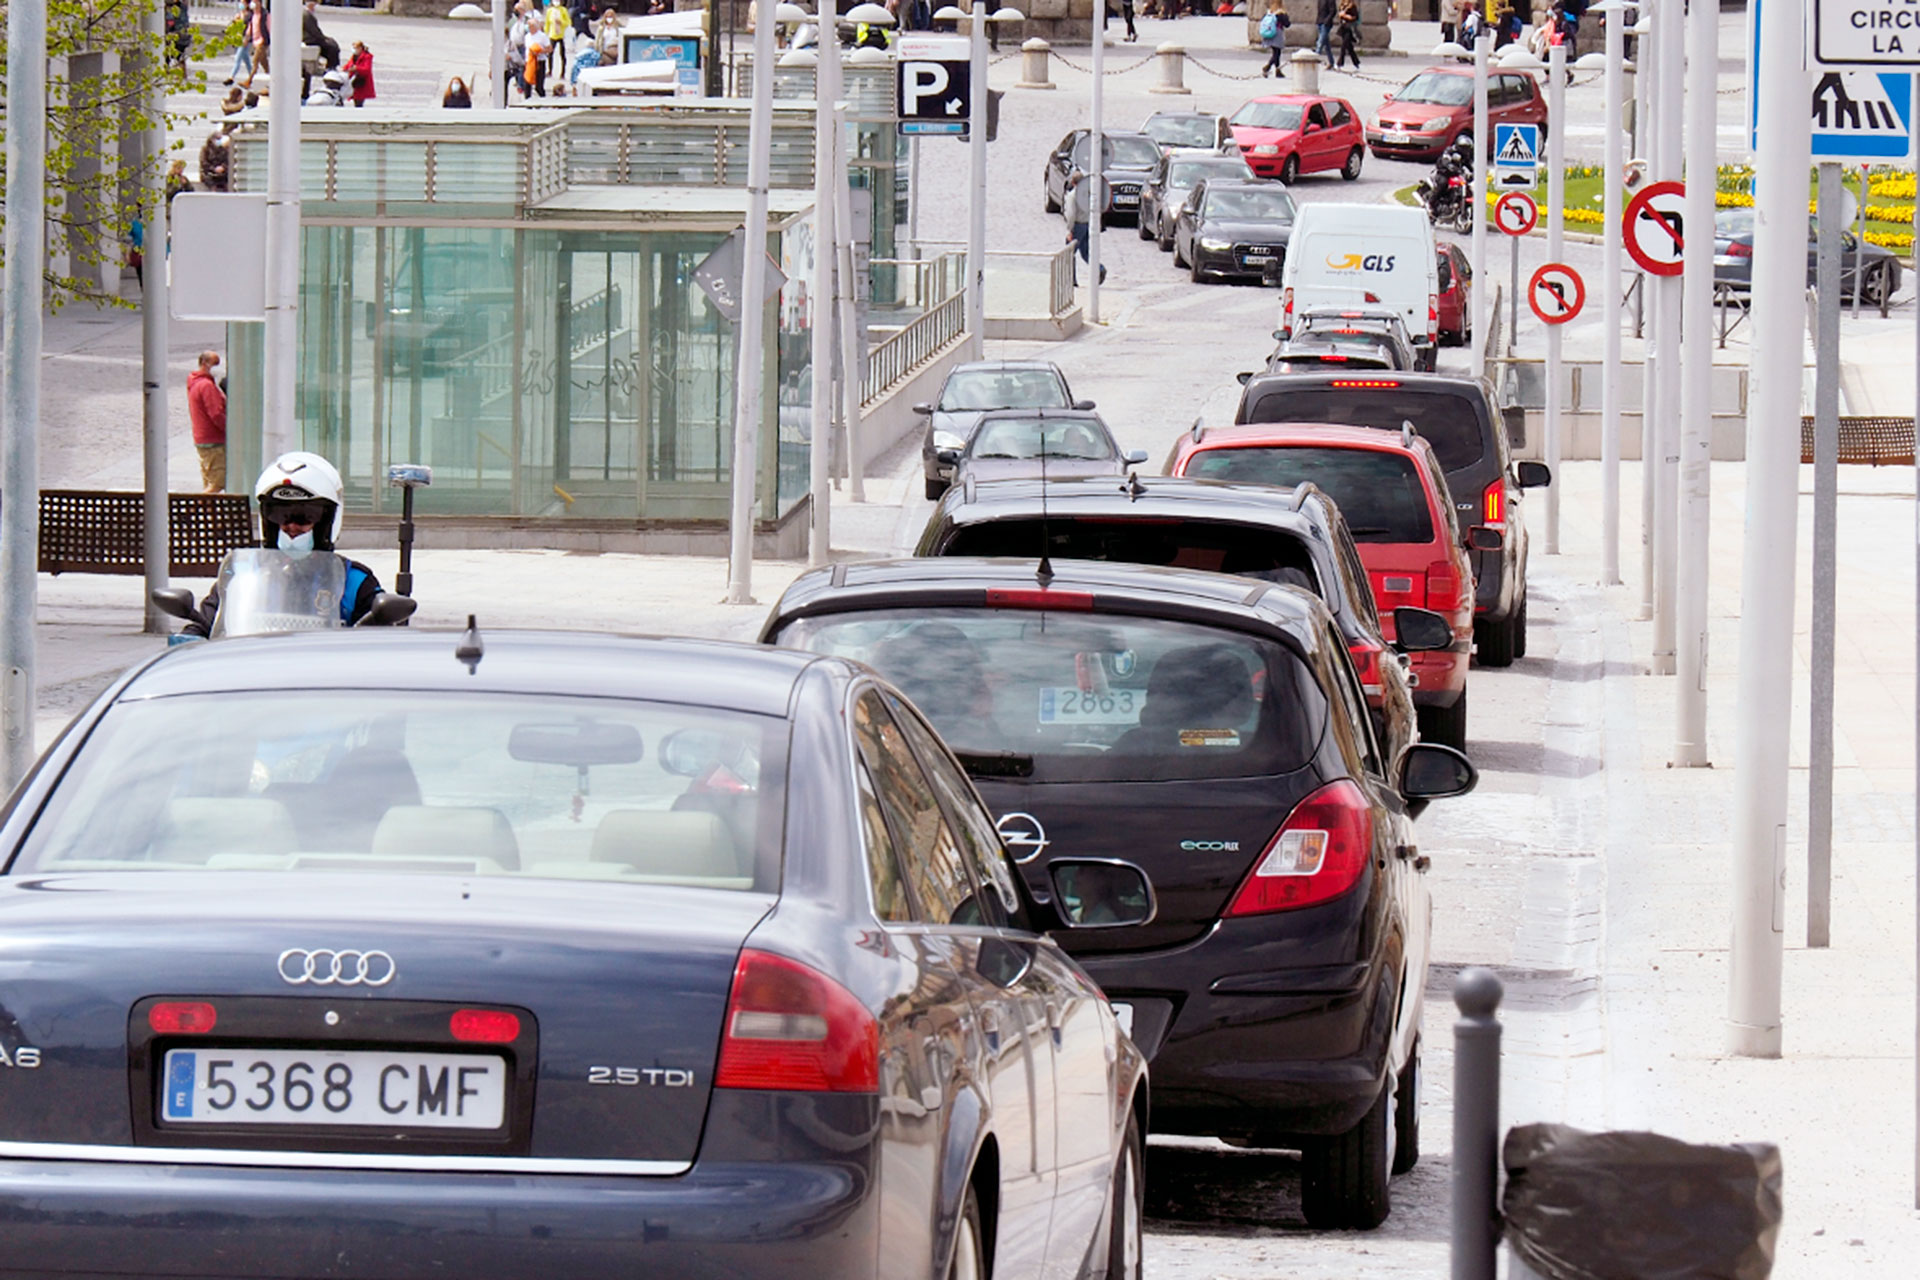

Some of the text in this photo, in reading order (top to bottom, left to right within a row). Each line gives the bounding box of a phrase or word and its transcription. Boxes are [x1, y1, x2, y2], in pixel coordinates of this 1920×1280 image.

[1873, 34, 1903, 53] LA
[903, 61, 949, 115] P
[1363, 255, 1396, 272] GLS
[588, 1066, 694, 1087] 2.5 TDI
[174, 1060, 489, 1117] E 5368 CMF
